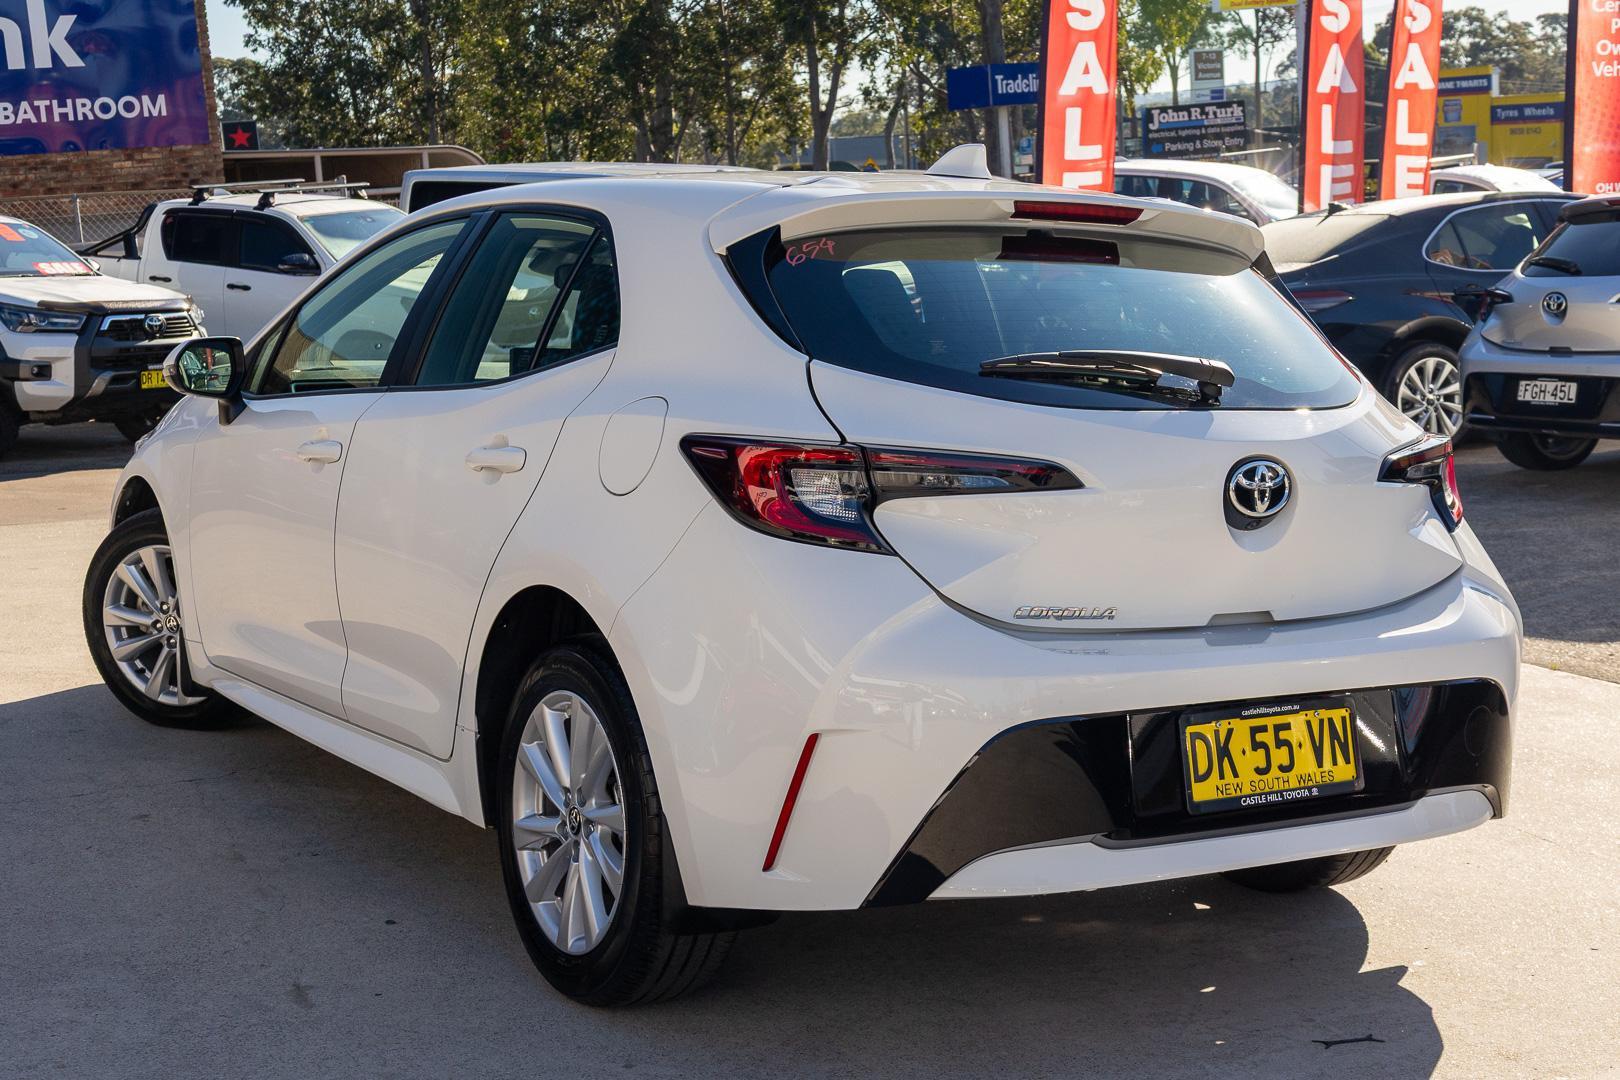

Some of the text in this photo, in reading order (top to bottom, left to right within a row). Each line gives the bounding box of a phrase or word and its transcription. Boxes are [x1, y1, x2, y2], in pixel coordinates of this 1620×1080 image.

[0, 94, 167, 125] BATHROOM
[1496, 106, 1555, 119] Tyres Wheels
[1148, 109, 1189, 130] John
[1164, 137, 1245, 152] Parking & Store Entry
[1013, 605, 1118, 621] COROLLA
[1241, 704, 1300, 716] castlehilltoyota.com.au
[1215, 770, 1335, 797] NEW SOUTH WALES
[1240, 788, 1310, 806] CASTLE HILL TOYOTA
